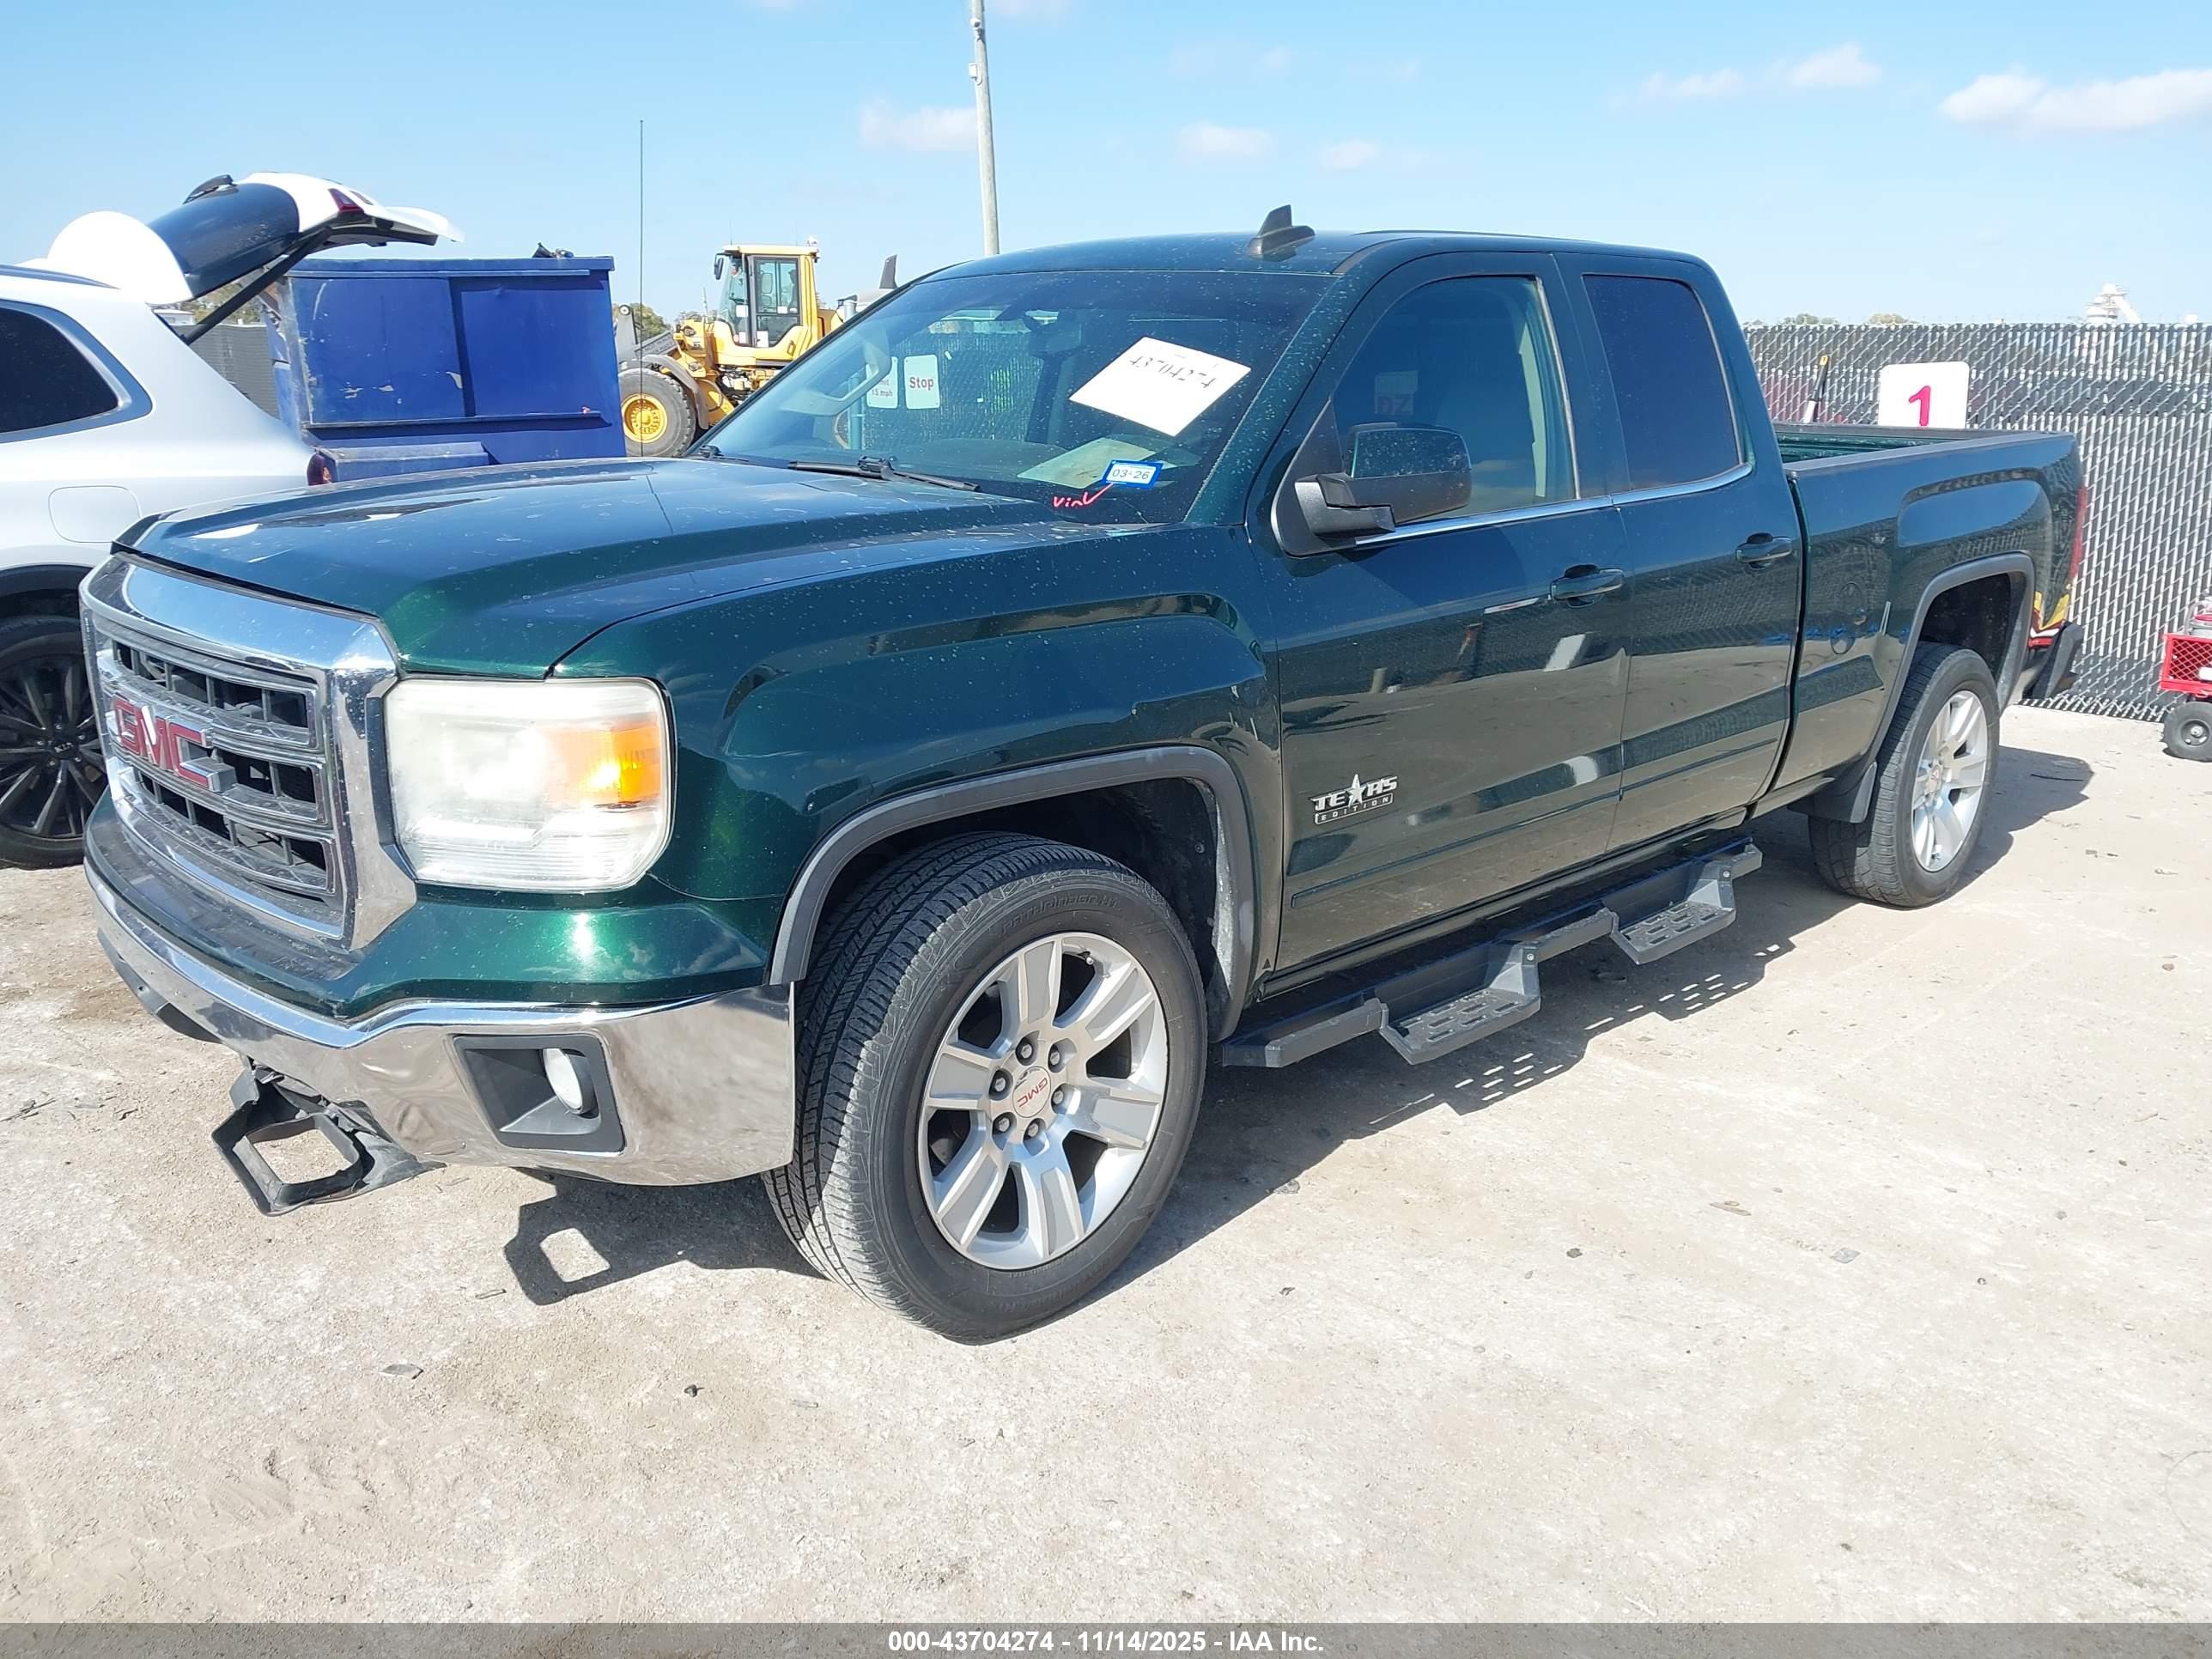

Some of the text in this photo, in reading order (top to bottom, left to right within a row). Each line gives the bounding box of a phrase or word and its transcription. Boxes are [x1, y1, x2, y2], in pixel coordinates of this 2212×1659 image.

[880, 389, 893, 398] mph
[909, 377, 934, 391] Stop
[1908, 385, 1931, 427] 1
[108, 696, 215, 792] GMC
[1310, 774, 1399, 811] TEXAS
[1321, 798, 1389, 821] EDITION
[1017, 1077, 1048, 1108] GMC
